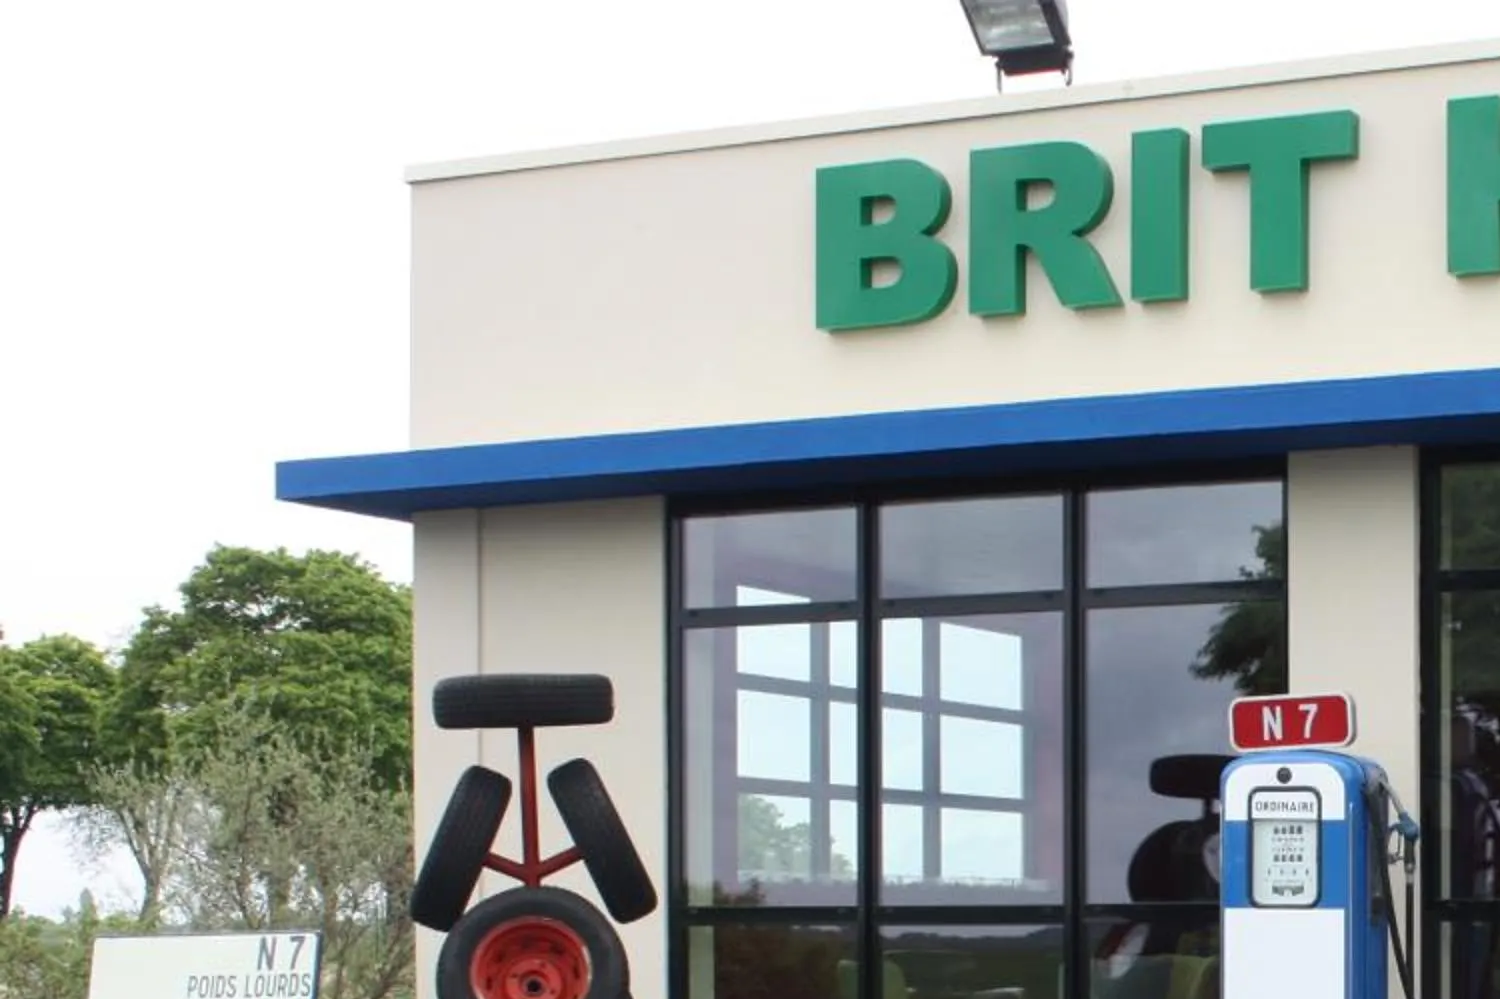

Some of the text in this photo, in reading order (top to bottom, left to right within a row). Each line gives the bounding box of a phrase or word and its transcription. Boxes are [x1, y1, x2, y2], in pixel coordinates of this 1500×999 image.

[815, 109, 1361, 333] BRIT
[1262, 703, 1319, 742] N 7
[1254, 800, 1315, 814] ORDINAIRE
[257, 936, 305, 971] N 7
[186, 973, 311, 999] POIDS LOURDS
